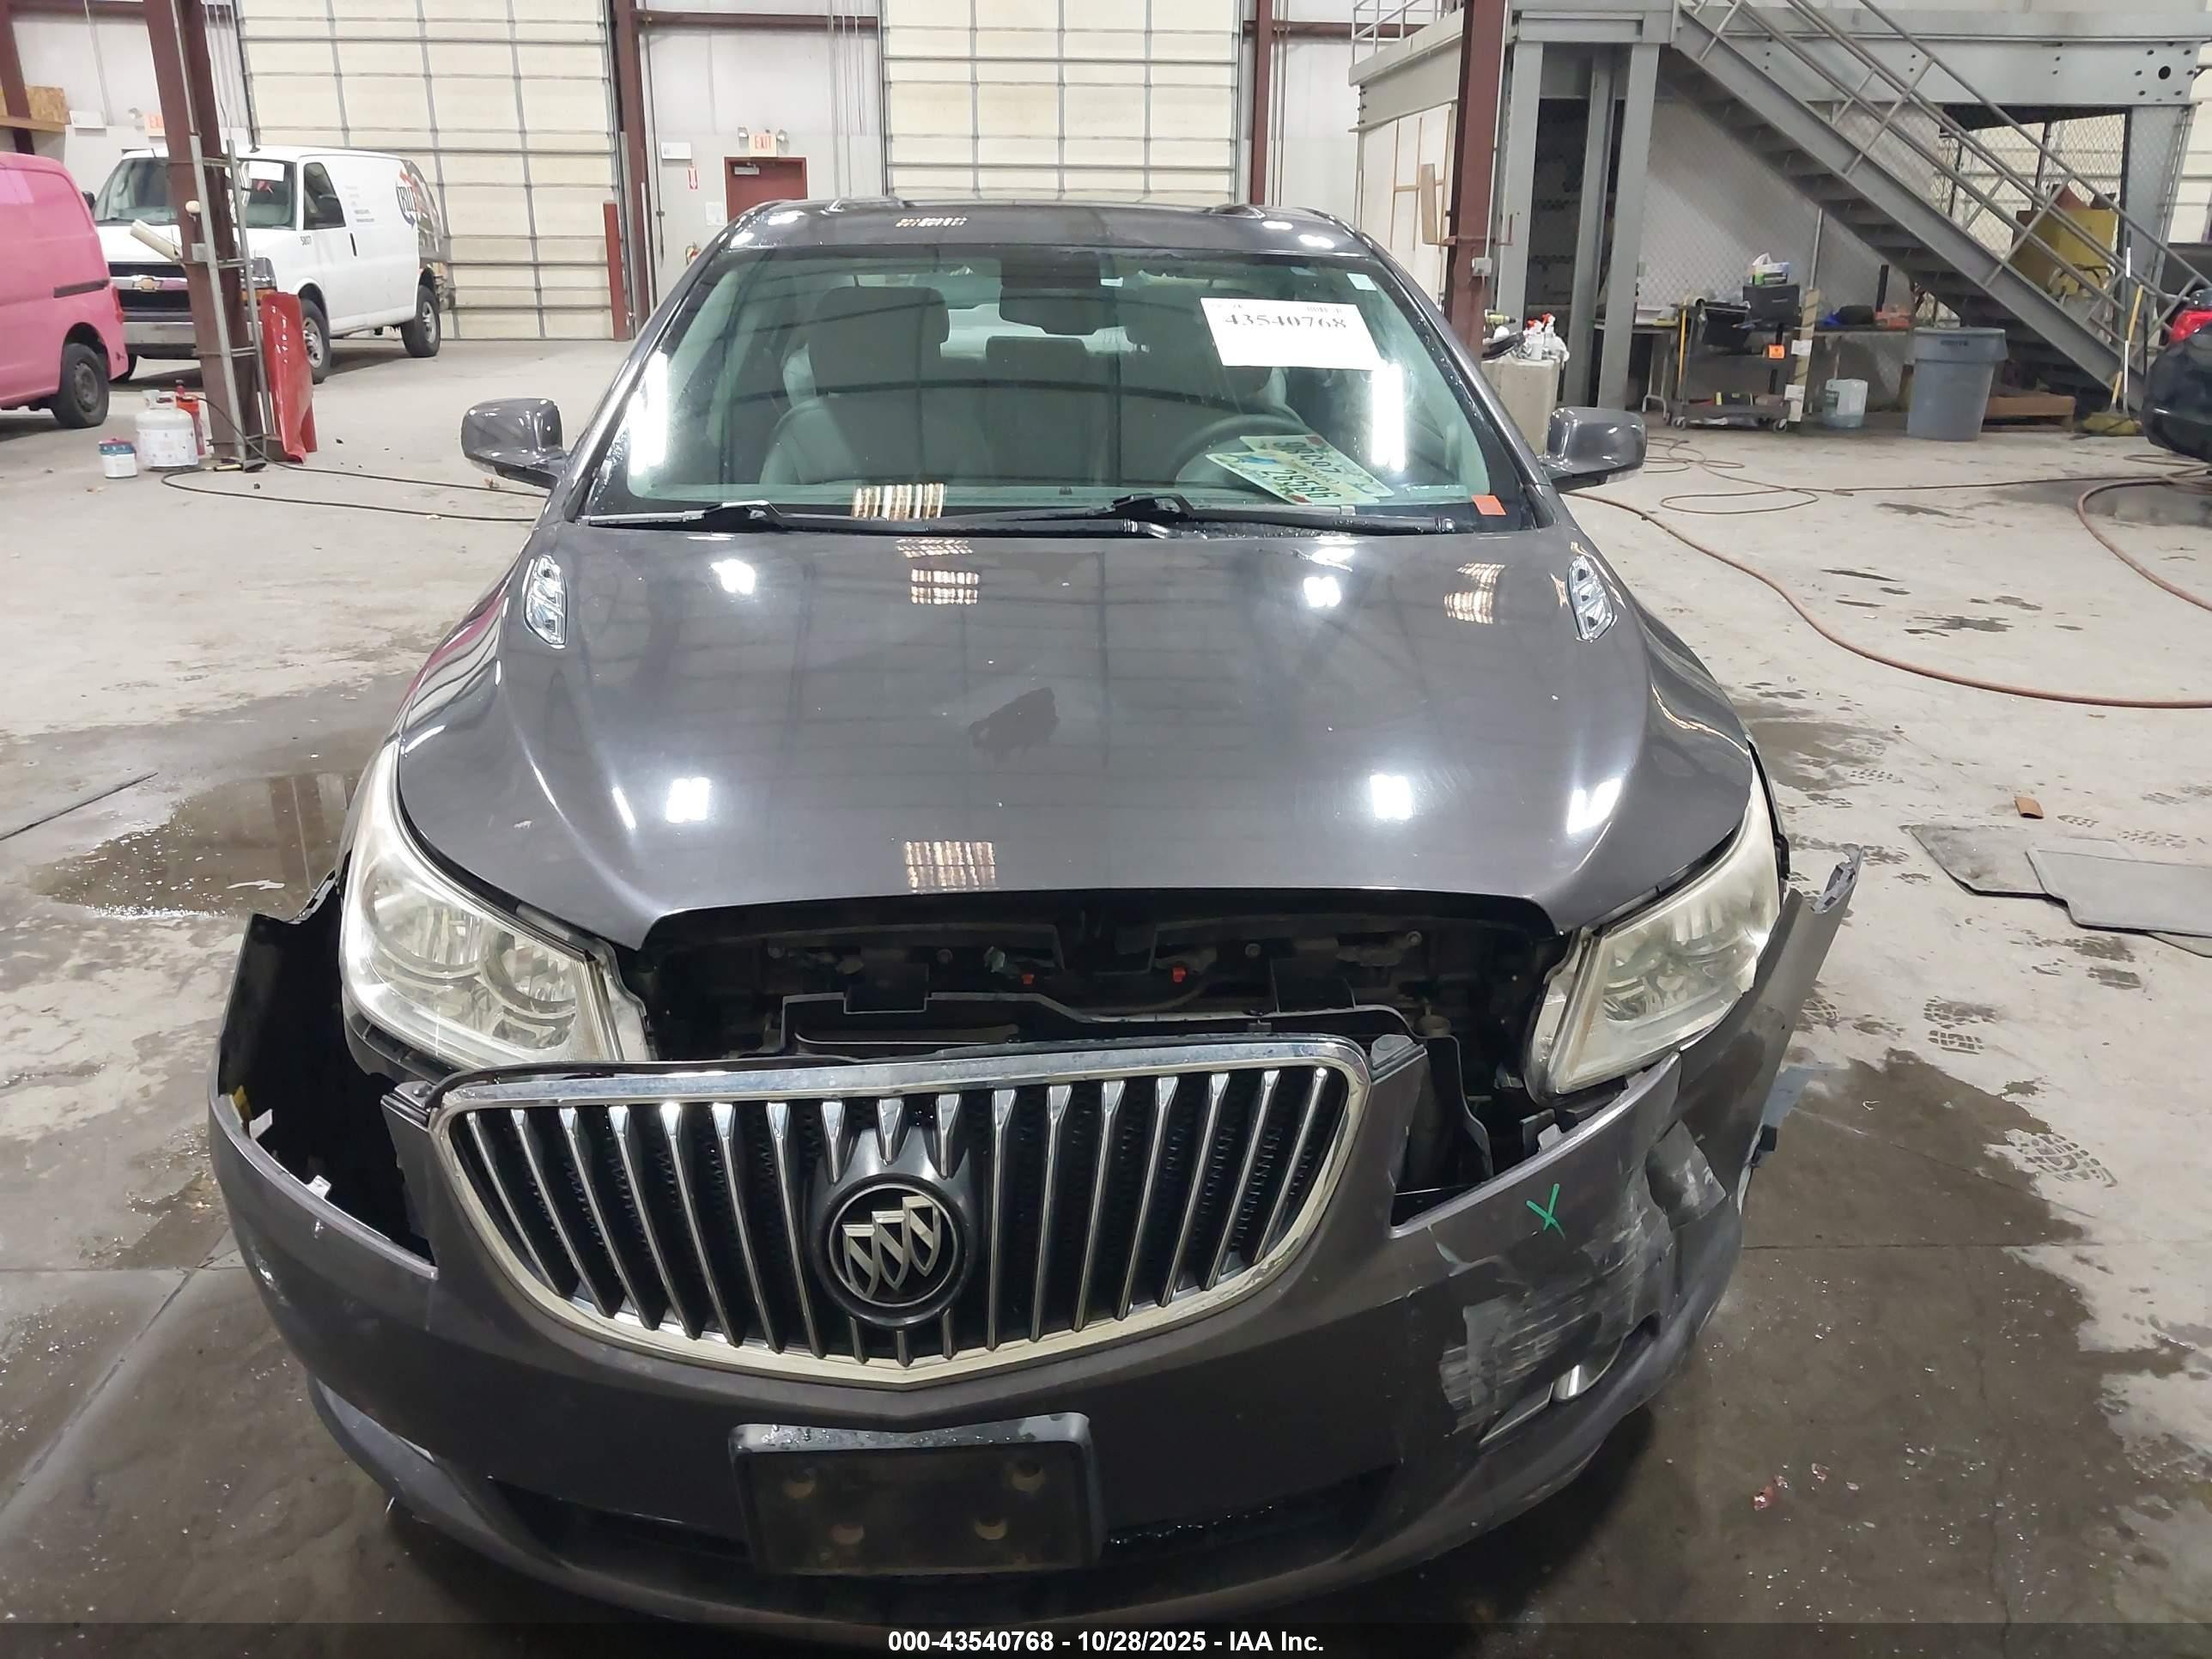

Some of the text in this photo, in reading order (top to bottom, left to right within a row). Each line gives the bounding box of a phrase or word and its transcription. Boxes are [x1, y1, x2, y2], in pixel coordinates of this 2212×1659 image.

[755, 135, 771, 149] EXIT
[1225, 313, 1347, 328] 43540768
[1261, 468, 1342, 499] 28586
